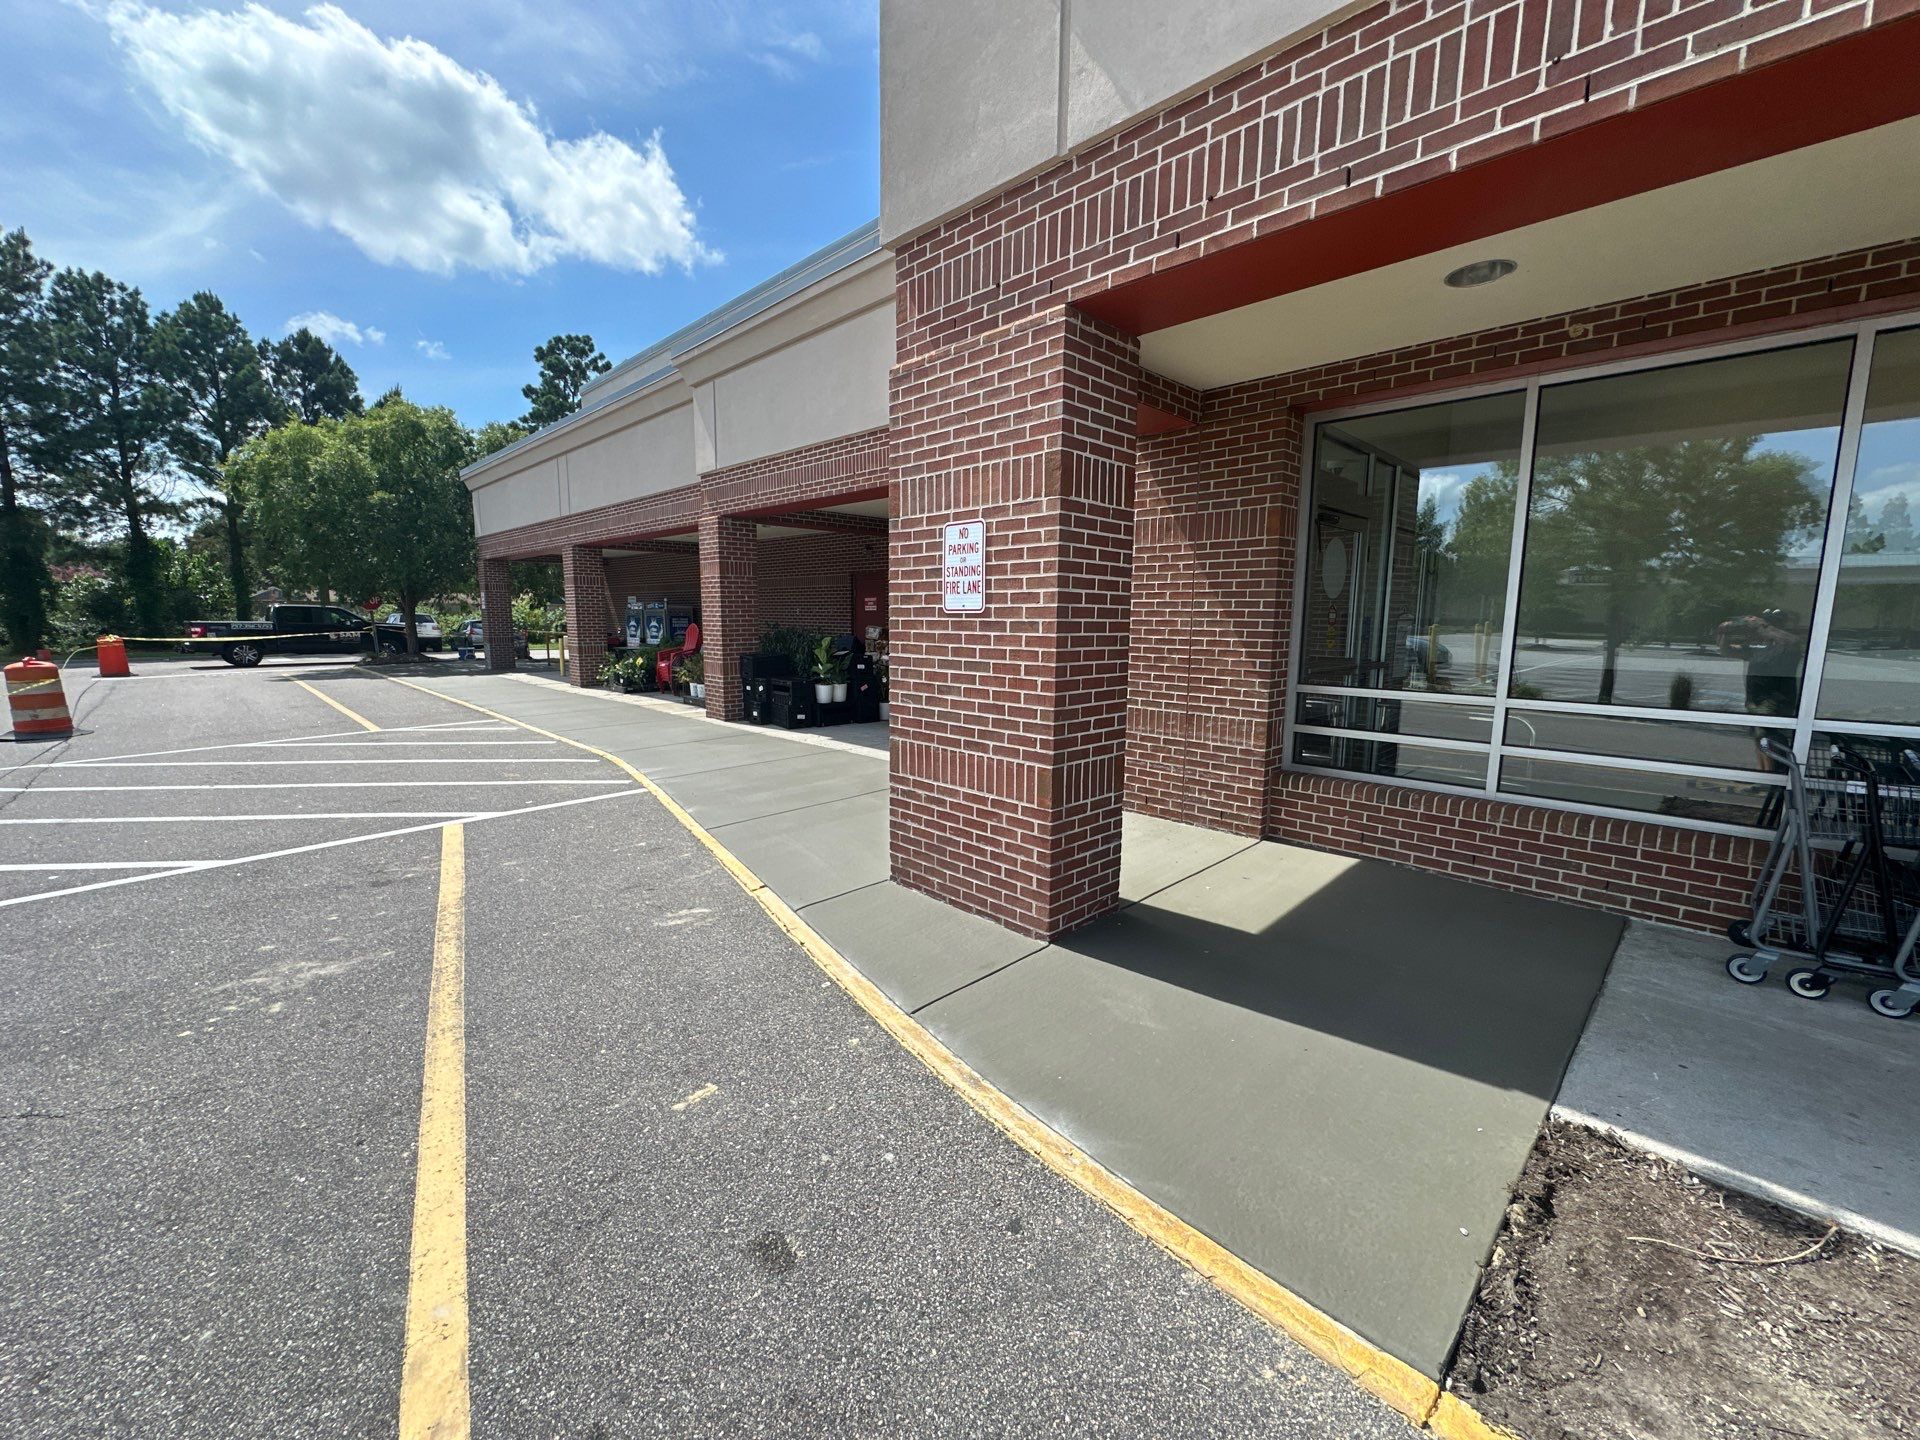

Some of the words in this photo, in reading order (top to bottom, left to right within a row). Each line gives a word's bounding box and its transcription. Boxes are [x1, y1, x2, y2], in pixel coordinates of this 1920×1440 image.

[958, 527, 969, 539] NO
[948, 542, 979, 555] PARKING
[946, 565, 981, 577] STANDING
[945, 581, 960, 595] FIRE
[962, 580, 981, 594] LANE
